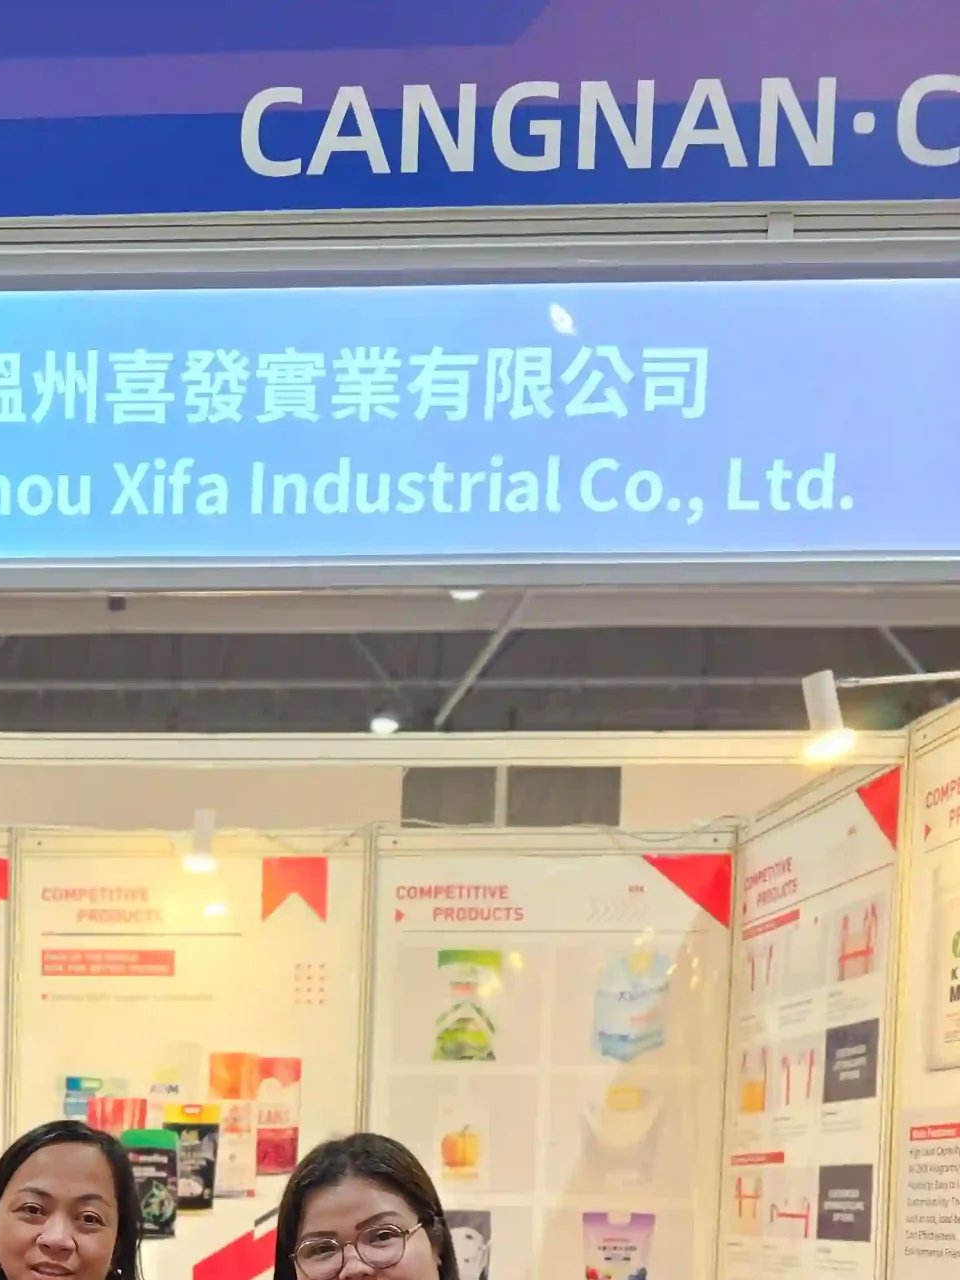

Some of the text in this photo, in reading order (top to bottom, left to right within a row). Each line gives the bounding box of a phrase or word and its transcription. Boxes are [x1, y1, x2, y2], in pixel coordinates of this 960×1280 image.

[112, 455, 229, 518] Xifa
[250, 453, 561, 515] Industrial
[579, 455, 704, 522] Co.,
[726, 450, 854, 512] Ltd.
[40, 886, 150, 903] COMPETITIVE
[395, 884, 510, 900] COMPETITIVE
[432, 906, 525, 922] PRODUCTS
